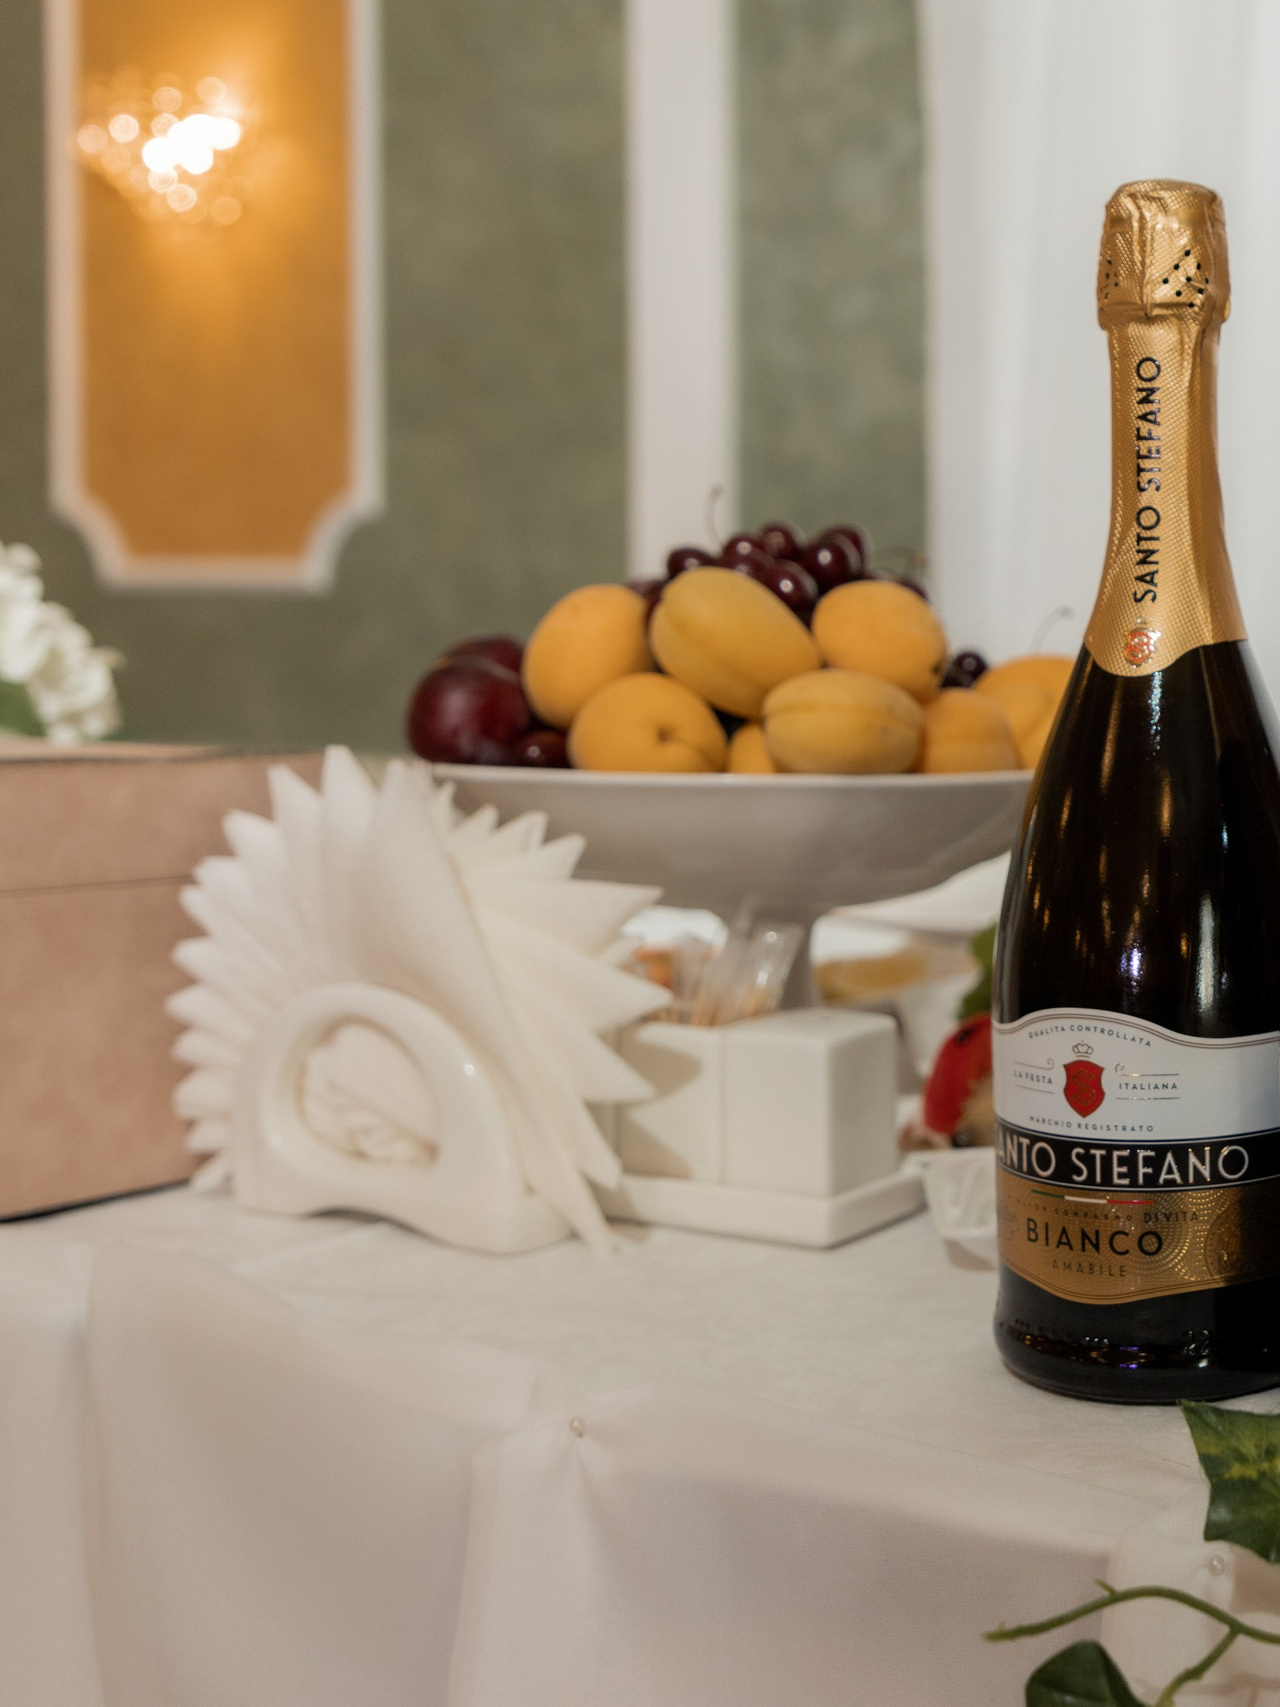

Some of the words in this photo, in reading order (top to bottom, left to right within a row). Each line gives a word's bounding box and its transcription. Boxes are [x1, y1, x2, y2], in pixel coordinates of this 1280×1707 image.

[1136, 356, 1162, 492] STEFANO
[1133, 505, 1161, 604] SANTO
[1028, 1024, 1066, 1039] QUALITA
[1070, 1024, 1151, 1048] CONTROLLATA
[1013, 1069, 1023, 1078] LA
[1025, 1071, 1054, 1086] FESTA
[1118, 1082, 1179, 1091] ITALIANA
[1029, 1115, 1073, 1129] MARCHIO
[1077, 1121, 1155, 1133] REGISTRATO
[1071, 1145, 1249, 1186] STEFANO
[1026, 1217, 1163, 1256] BIANCO
[1052, 1258, 1126, 1278] AMABILE
